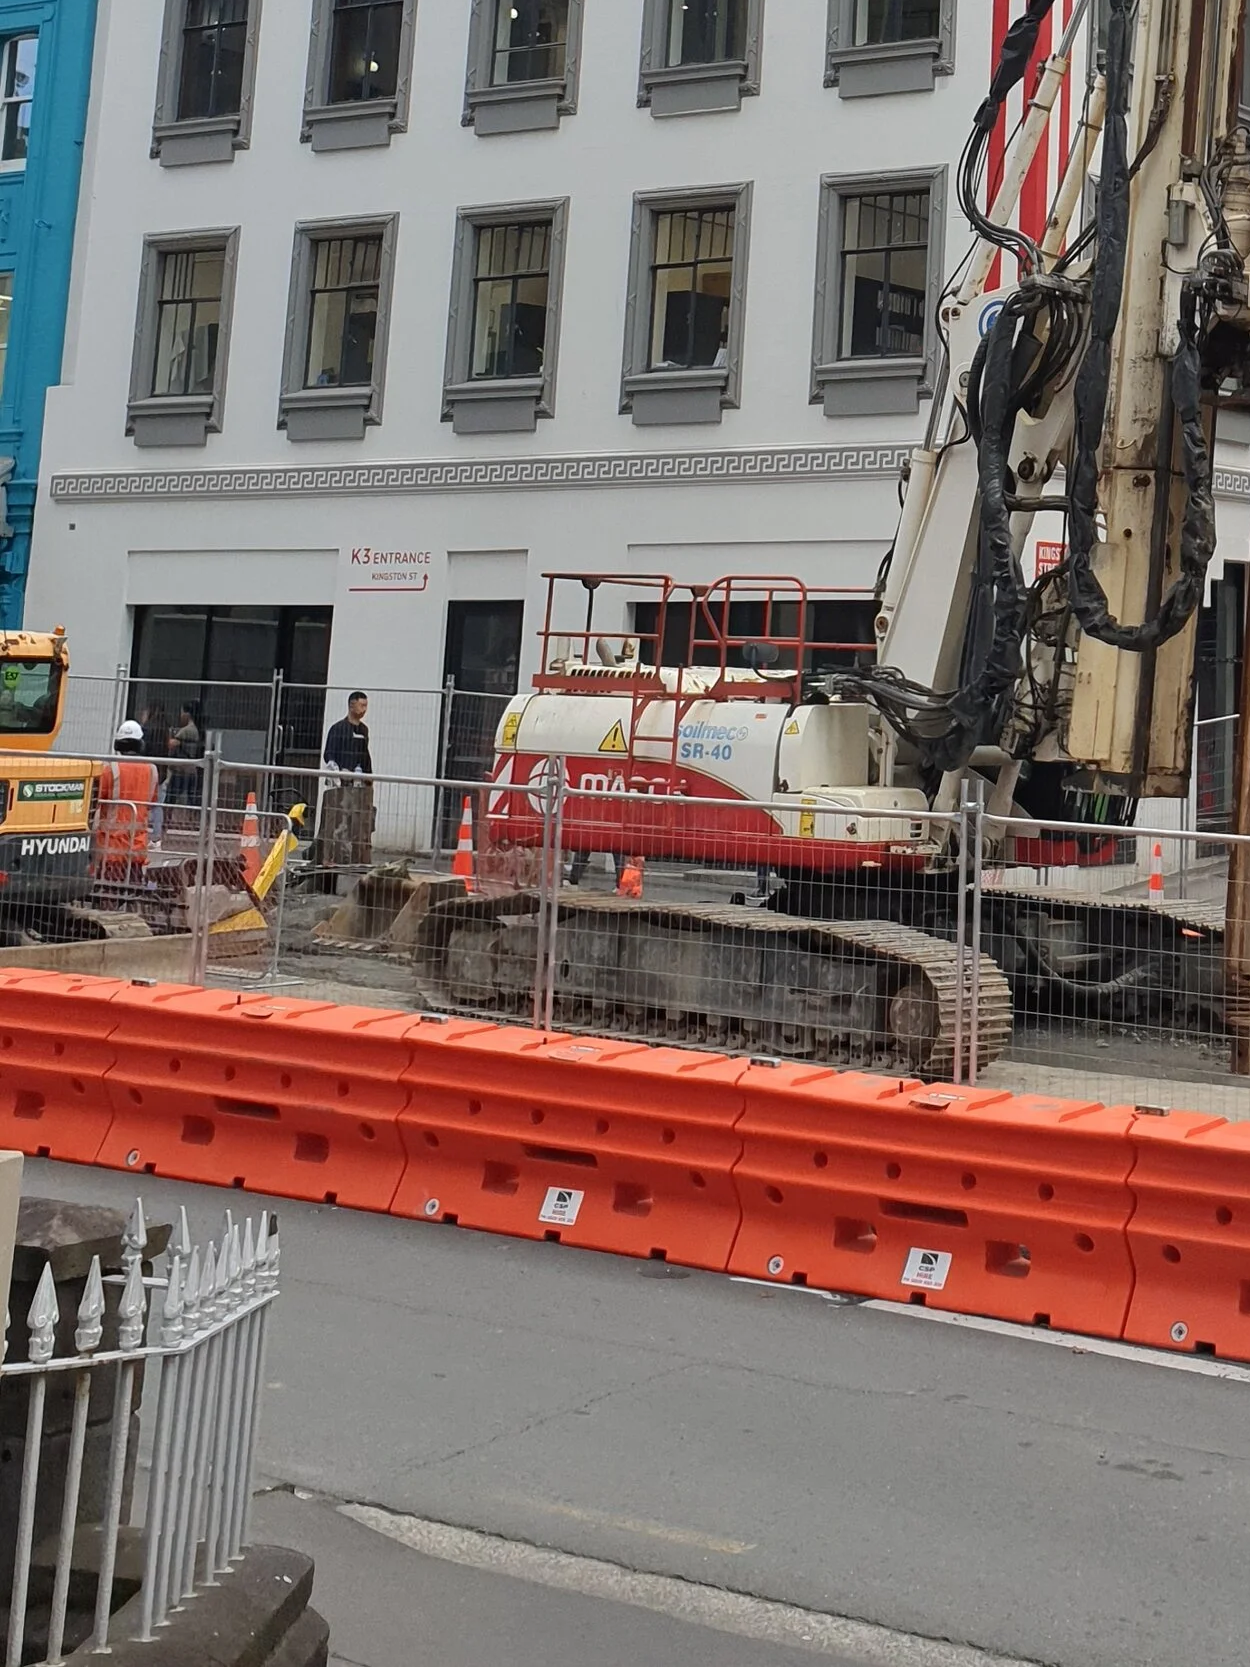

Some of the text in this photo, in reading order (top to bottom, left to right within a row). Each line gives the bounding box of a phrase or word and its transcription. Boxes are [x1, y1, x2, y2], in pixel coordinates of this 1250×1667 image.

[351, 548, 432, 565] K3 ENTRANCE
[371, 572, 418, 581] KINGSTON ST
[680, 742, 732, 761] SR-40
[21, 836, 91, 856] HYUNDAI
